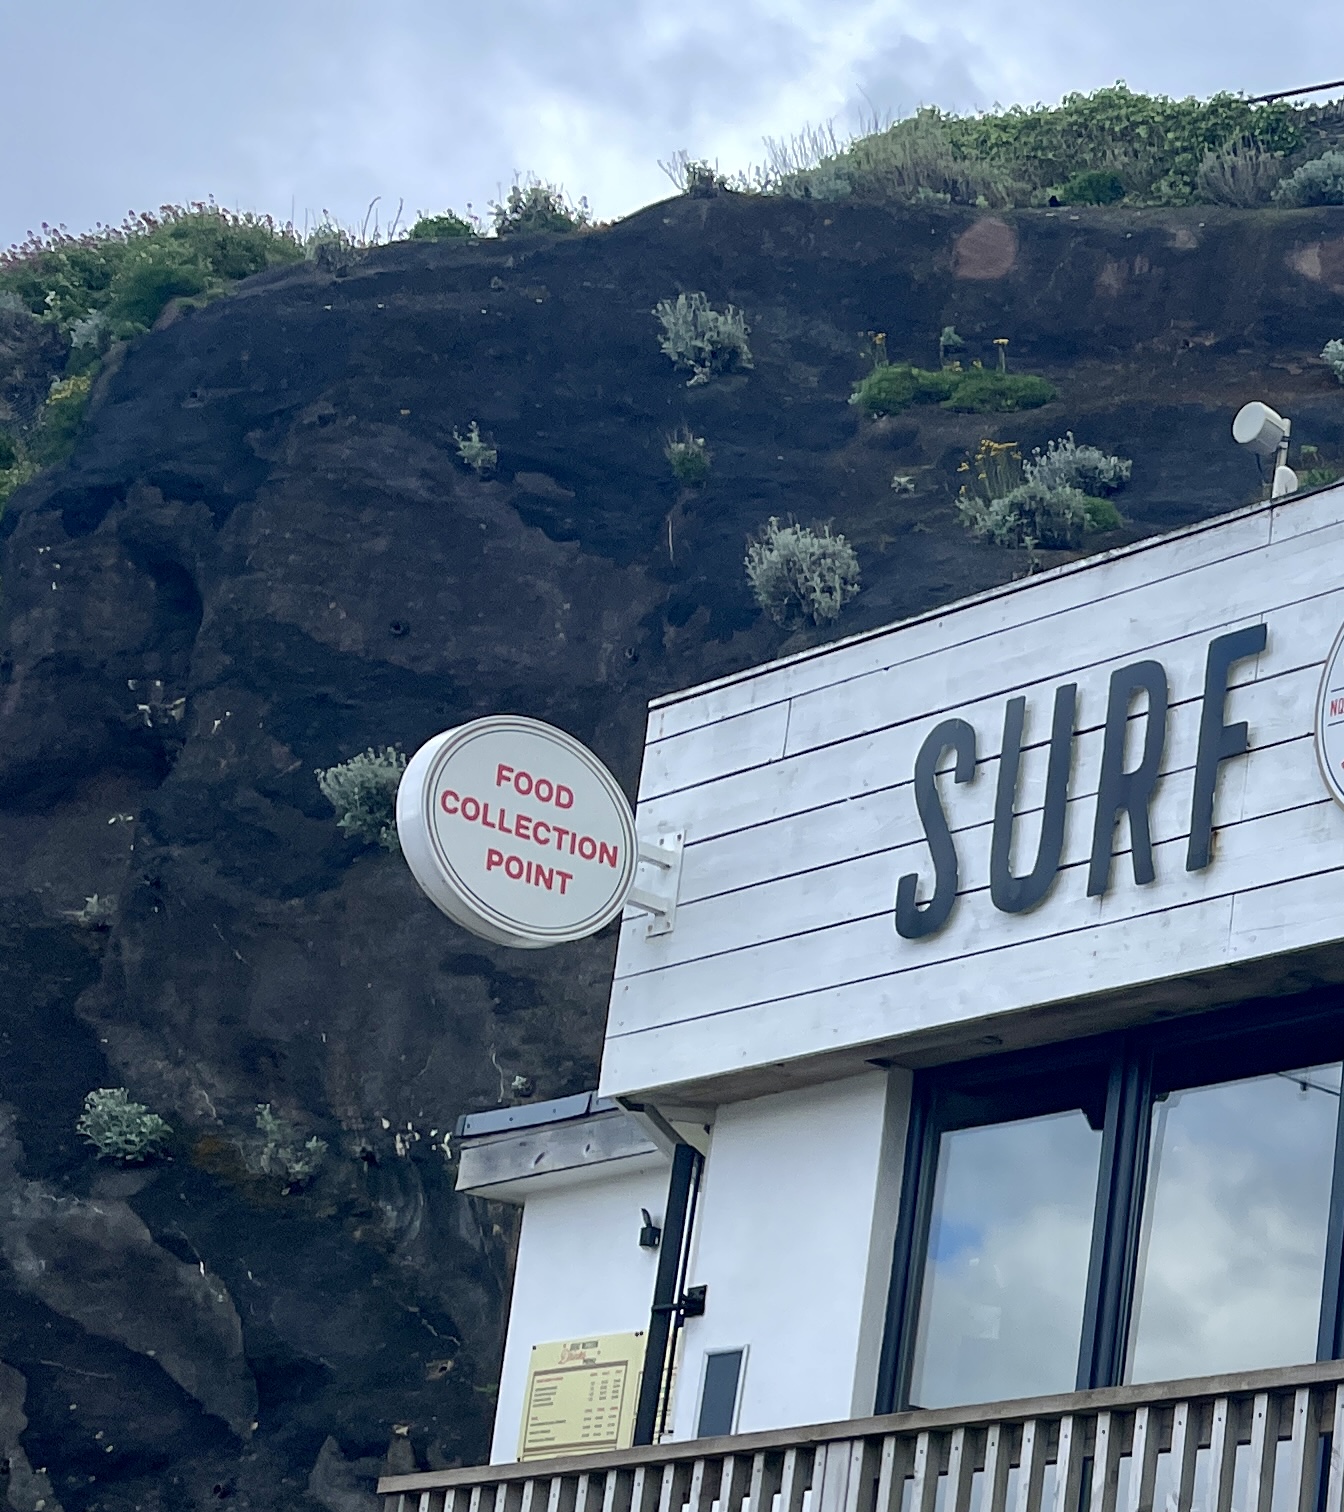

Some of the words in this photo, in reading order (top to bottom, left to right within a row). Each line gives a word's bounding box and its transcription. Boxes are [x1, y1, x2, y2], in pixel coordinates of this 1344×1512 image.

[496, 763, 574, 809] FOOD
[895, 623, 1267, 939] SURF
[441, 790, 618, 868] COLLECTION
[486, 848, 573, 894] POINT
